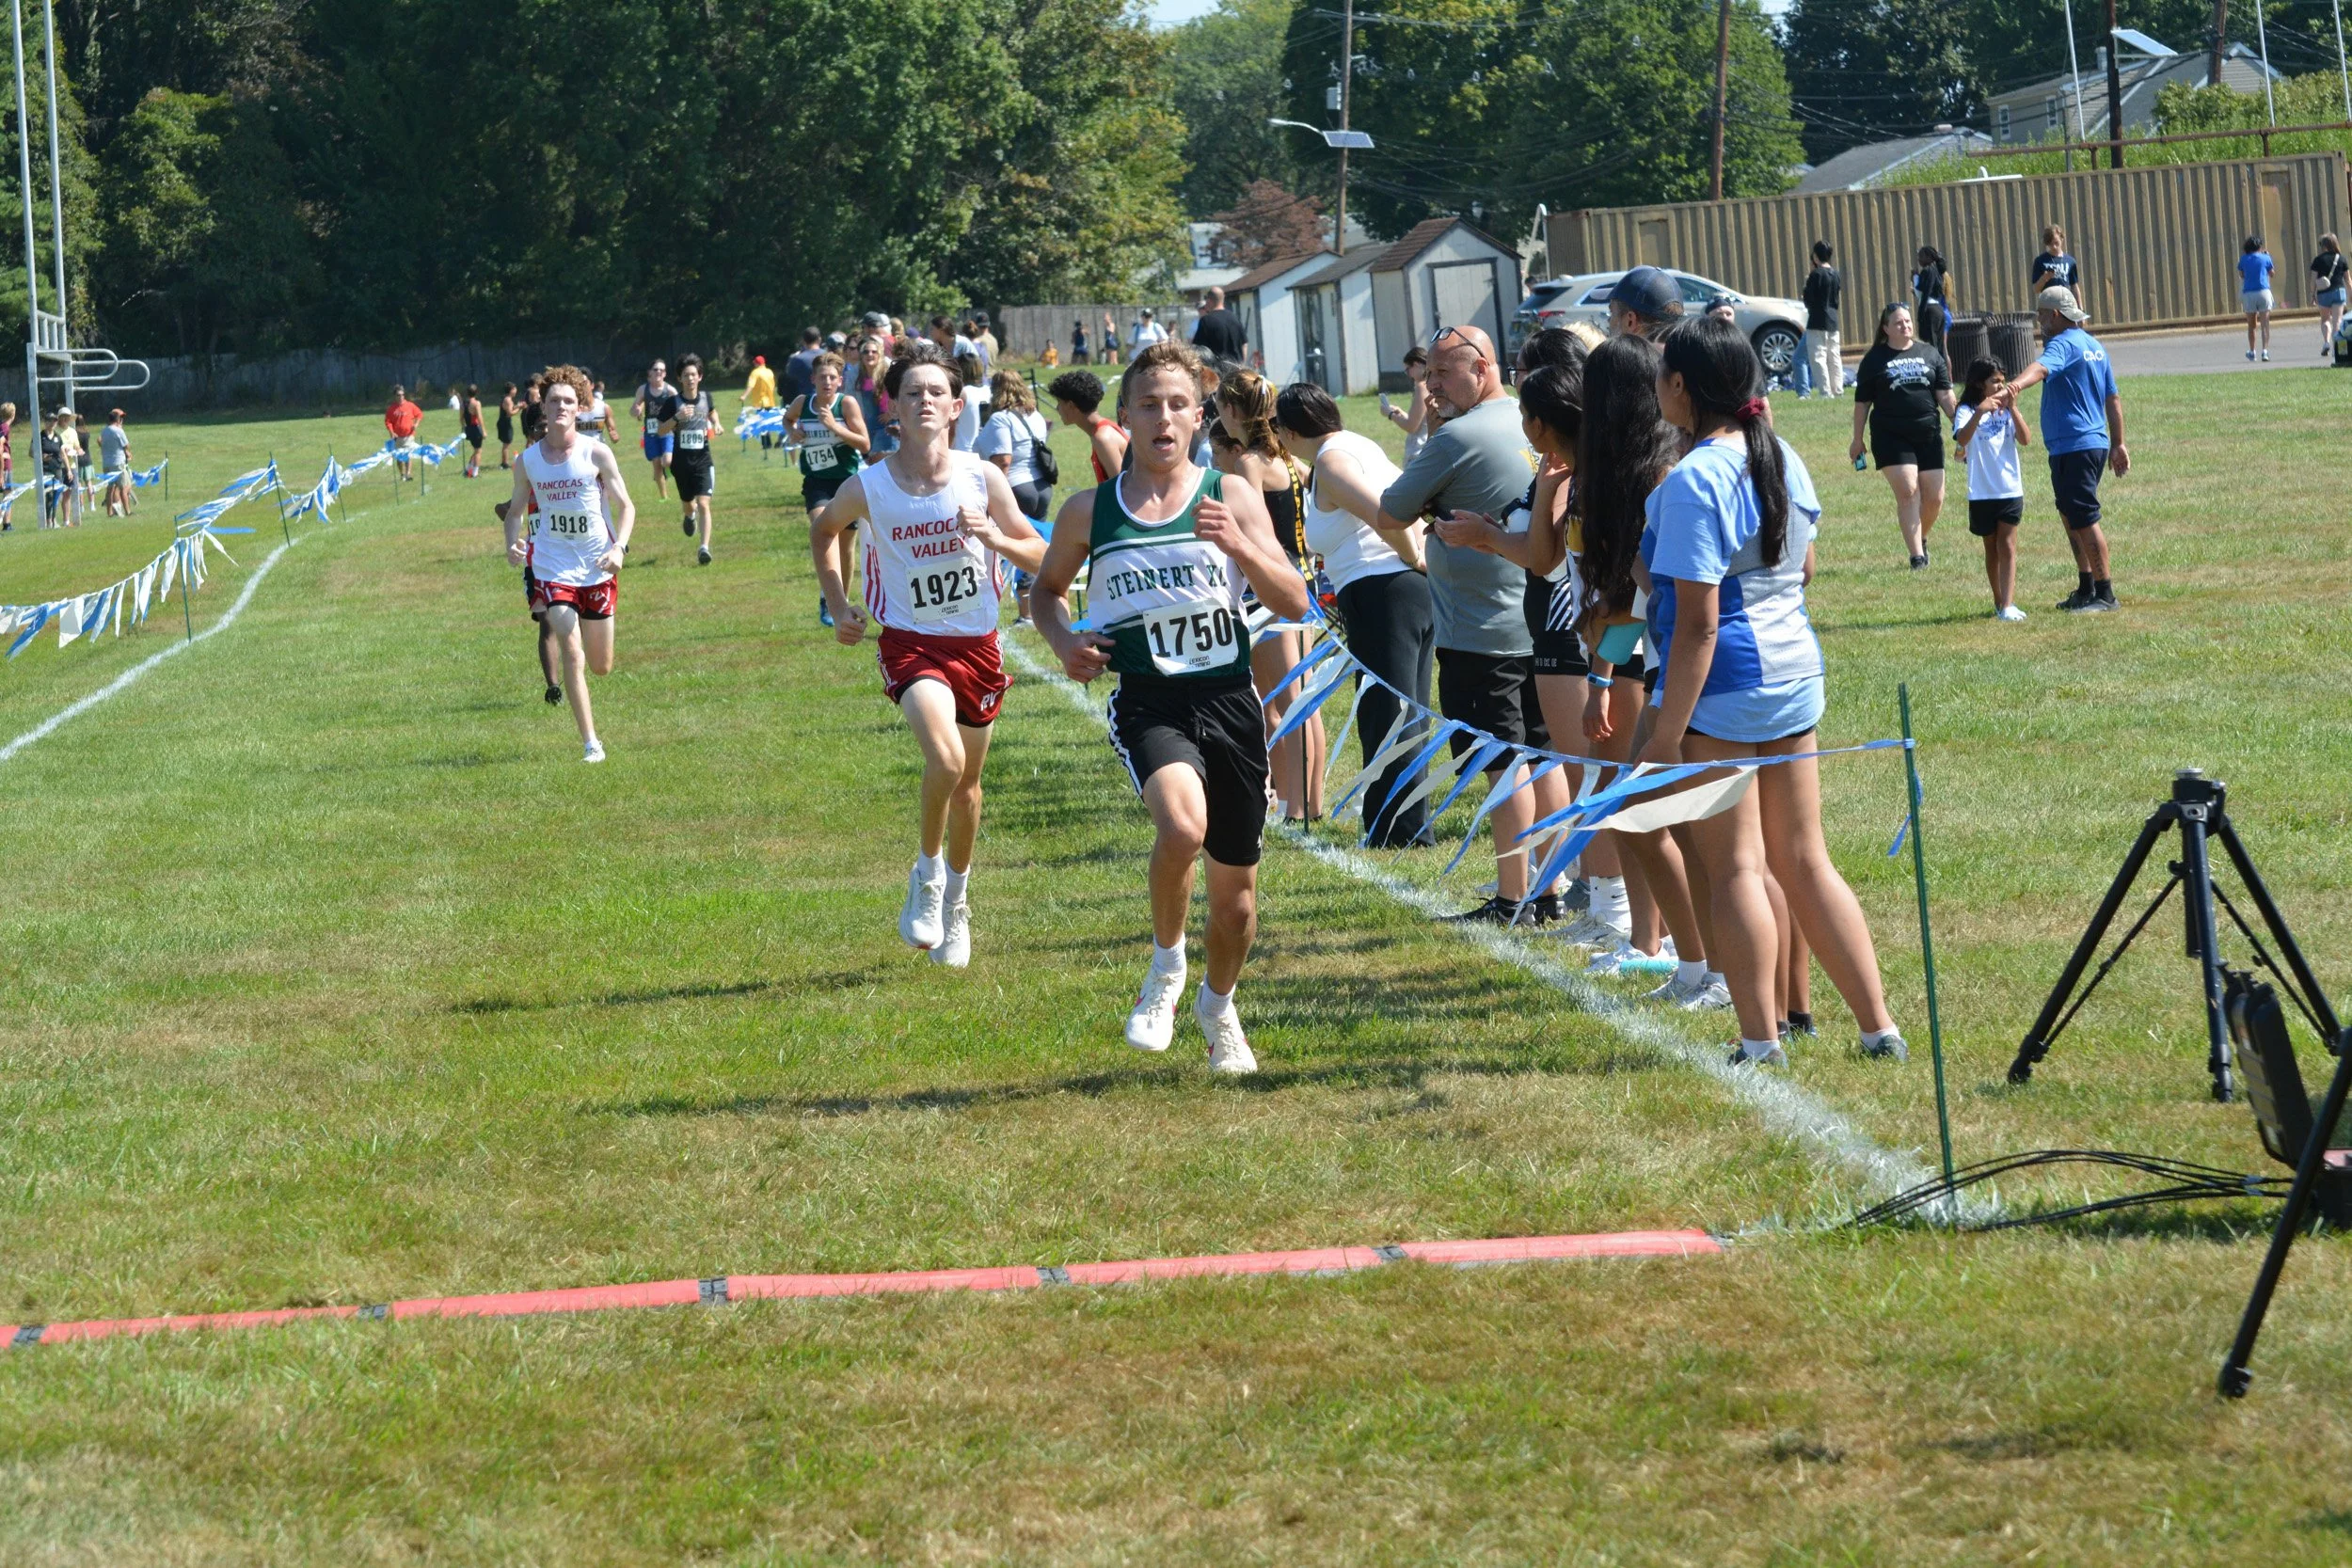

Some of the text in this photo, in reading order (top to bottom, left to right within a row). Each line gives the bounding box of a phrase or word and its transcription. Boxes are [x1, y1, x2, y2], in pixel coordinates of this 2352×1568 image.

[807, 448, 834, 466] 1754
[537, 479, 583, 491] RANCOCAS
[547, 490, 578, 501] VALLEY
[550, 514, 588, 533] 1918
[892, 518, 960, 542] RANCOC
[911, 535, 967, 559] VALLEY
[911, 566, 977, 610] 1923
[1106, 564, 1195, 600] STEINERT
[1150, 608, 1232, 658] 1750
[980, 690, 1001, 712] RV
